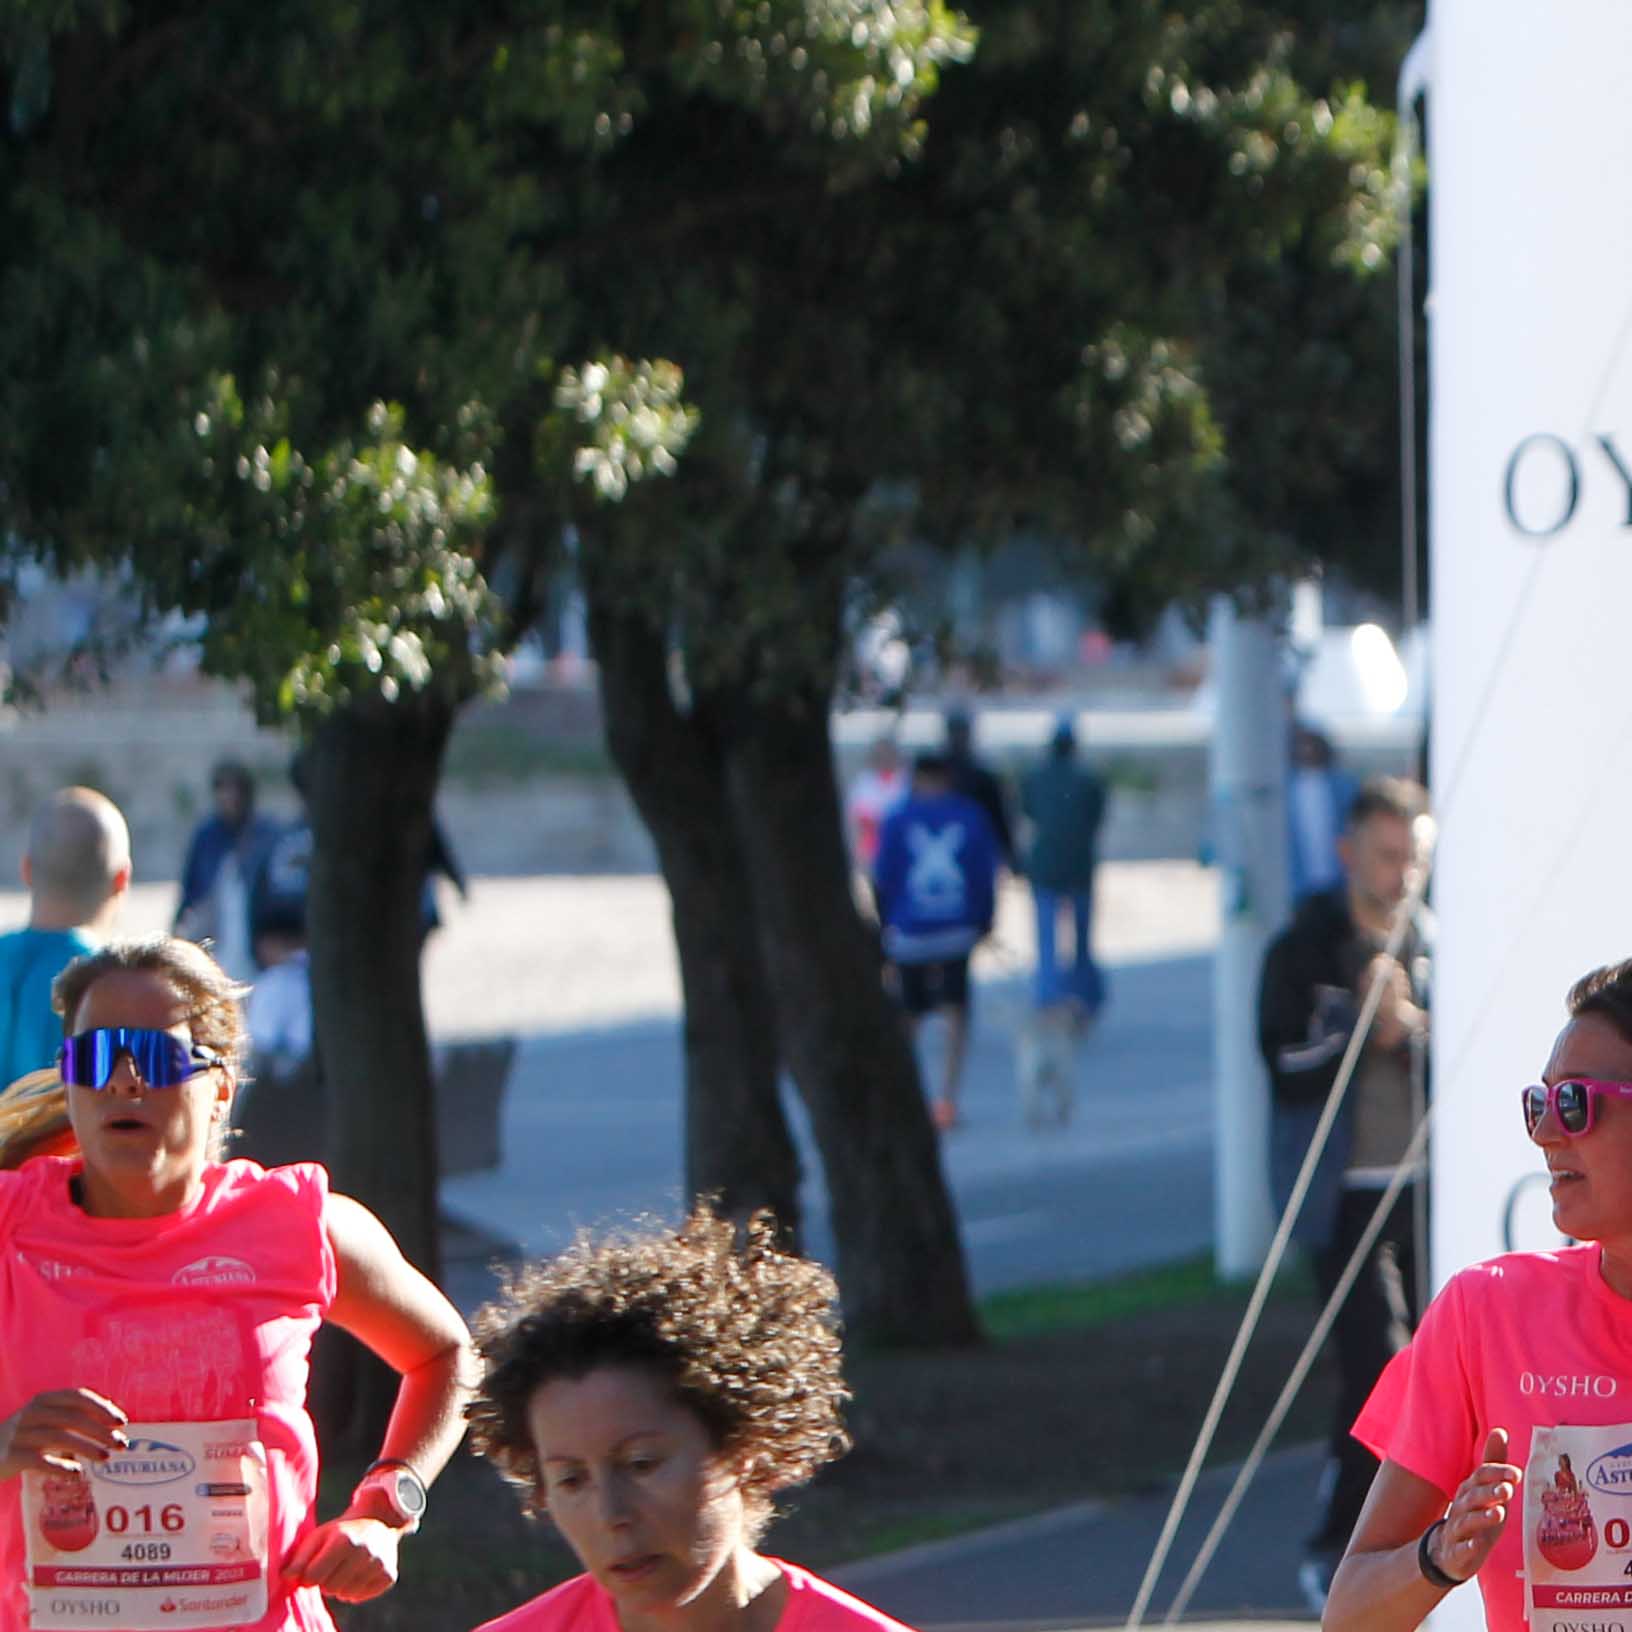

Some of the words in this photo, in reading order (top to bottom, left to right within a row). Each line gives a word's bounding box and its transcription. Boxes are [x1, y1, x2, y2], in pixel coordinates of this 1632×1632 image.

[1519, 1371, 1617, 1398] OYSHO
[105, 1503, 185, 1533] 016
[121, 1543, 172, 1562] 4089
[55, 1570, 117, 1584] CARRERA
[121, 1570, 141, 1584] DE
[144, 1570, 160, 1583] LA
[1555, 1590, 1620, 1605] CARRERA
[51, 1599, 120, 1616] OYSHO
